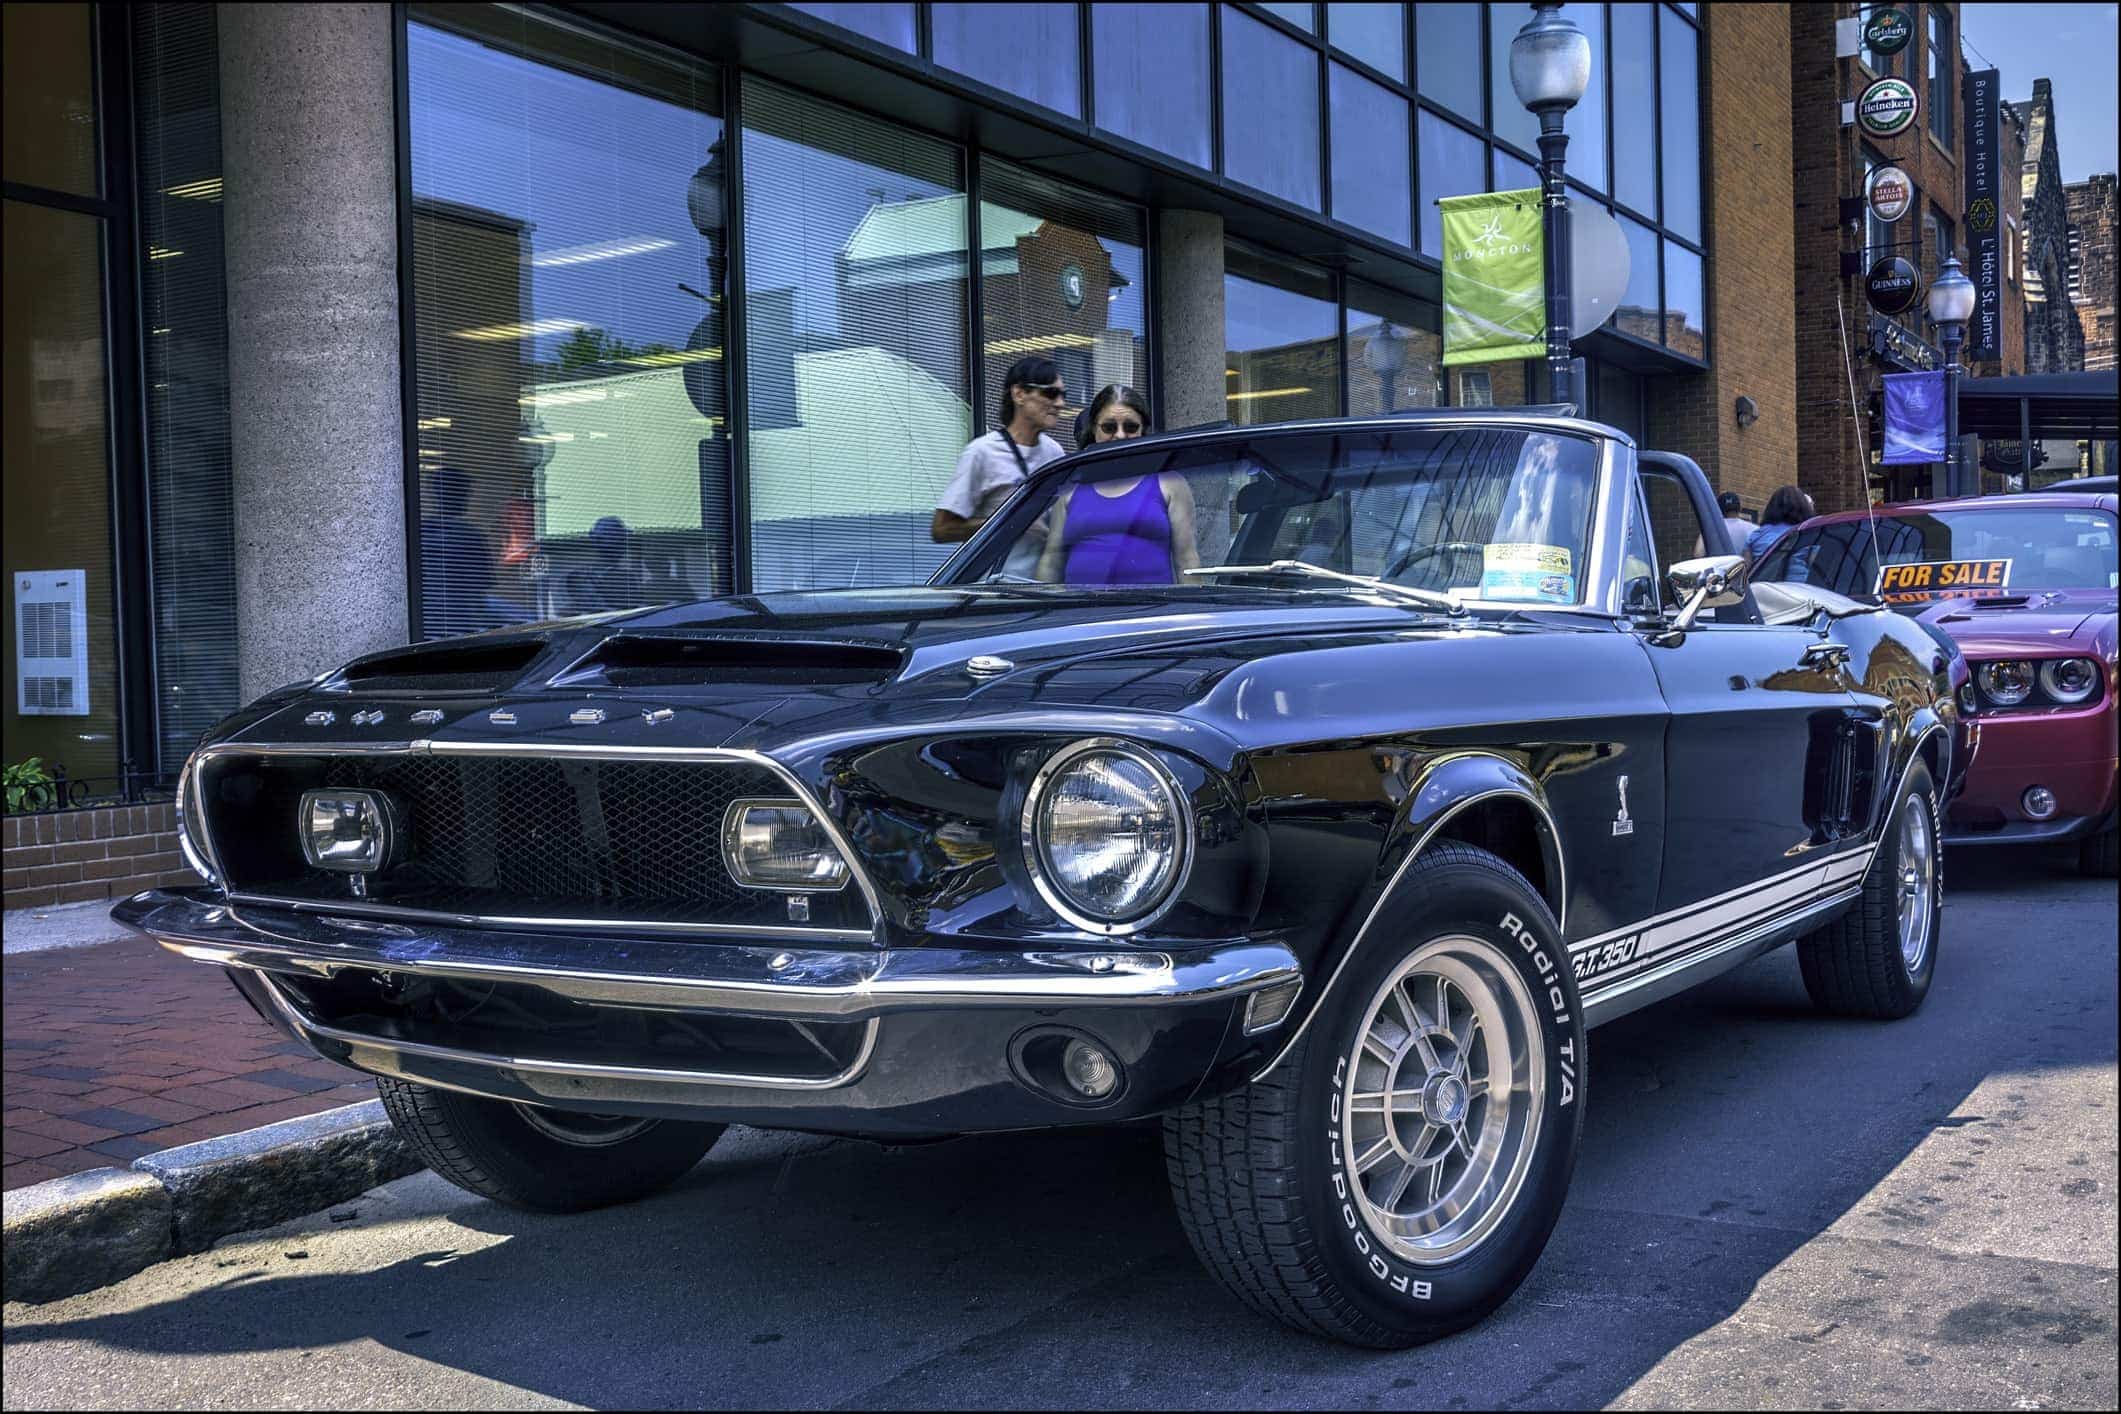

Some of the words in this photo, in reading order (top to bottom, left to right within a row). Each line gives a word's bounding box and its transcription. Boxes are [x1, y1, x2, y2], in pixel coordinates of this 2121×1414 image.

[1864, 99, 1910, 113] Heineken
[1974, 80, 1986, 145] Boutique
[1976, 152, 1988, 191] Hotel
[1875, 186, 1902, 195] STELLA
[1453, 243, 1531, 261] MONCTON
[1872, 278, 1912, 290] GUINNESS
[1981, 290, 1996, 307] St.
[1981, 309, 1995, 349] James
[1883, 565, 1932, 589] FOR
[1938, 561, 2003, 586] SALE
[1500, 911, 1571, 1025] Radial
[1559, 1037, 1574, 1107] T/A
[1328, 1055, 1432, 1300] BFGoodrich
